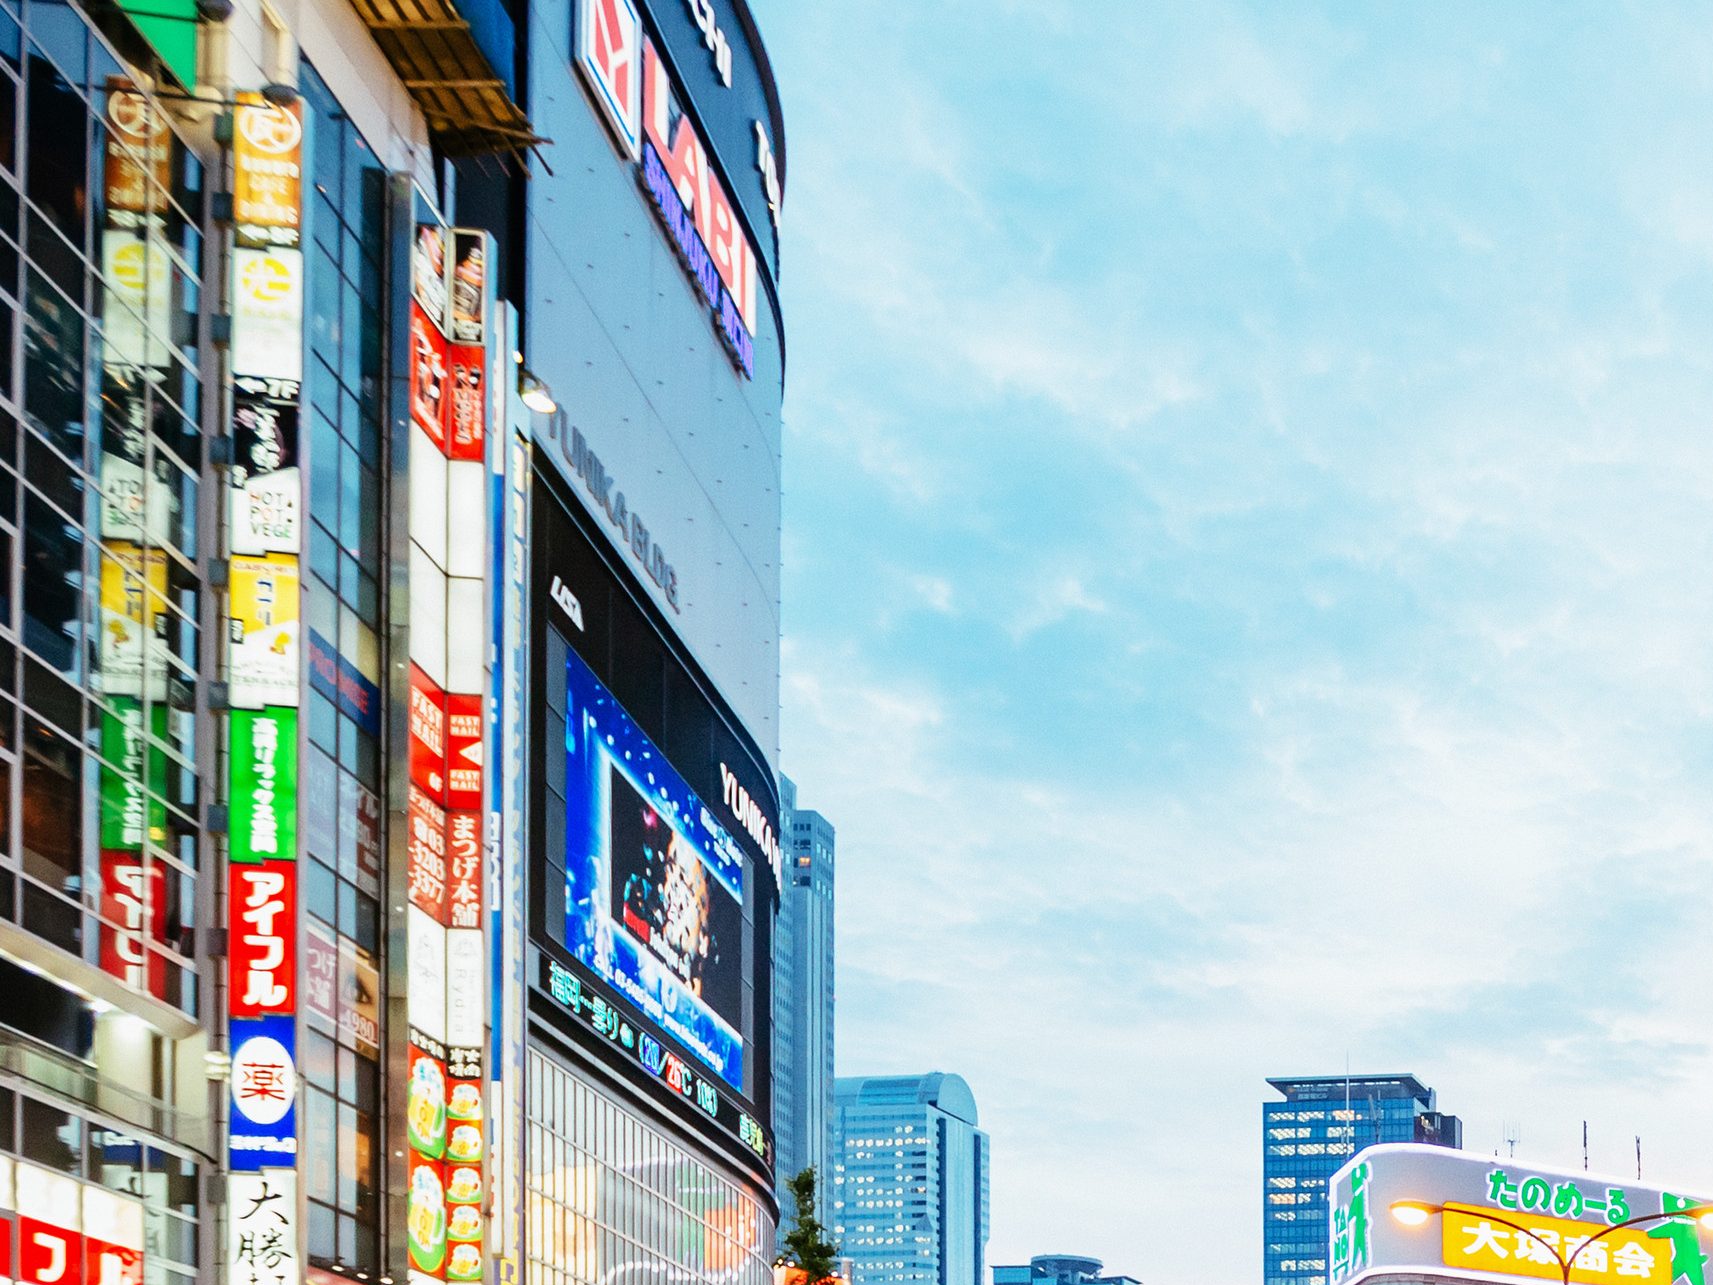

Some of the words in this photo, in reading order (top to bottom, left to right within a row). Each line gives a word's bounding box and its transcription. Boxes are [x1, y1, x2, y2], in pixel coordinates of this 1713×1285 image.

[643, 34, 757, 340] LABI
[450, 715, 481, 727] FAST
[450, 769, 481, 782] FAST
[450, 813, 482, 928] まつげ本舗
[242, 870, 288, 1007] アイフル
[240, 1062, 288, 1103] 薬
[1488, 1169, 1631, 1226] たのめーる
[1461, 1221, 1655, 1279] 大塚商会
